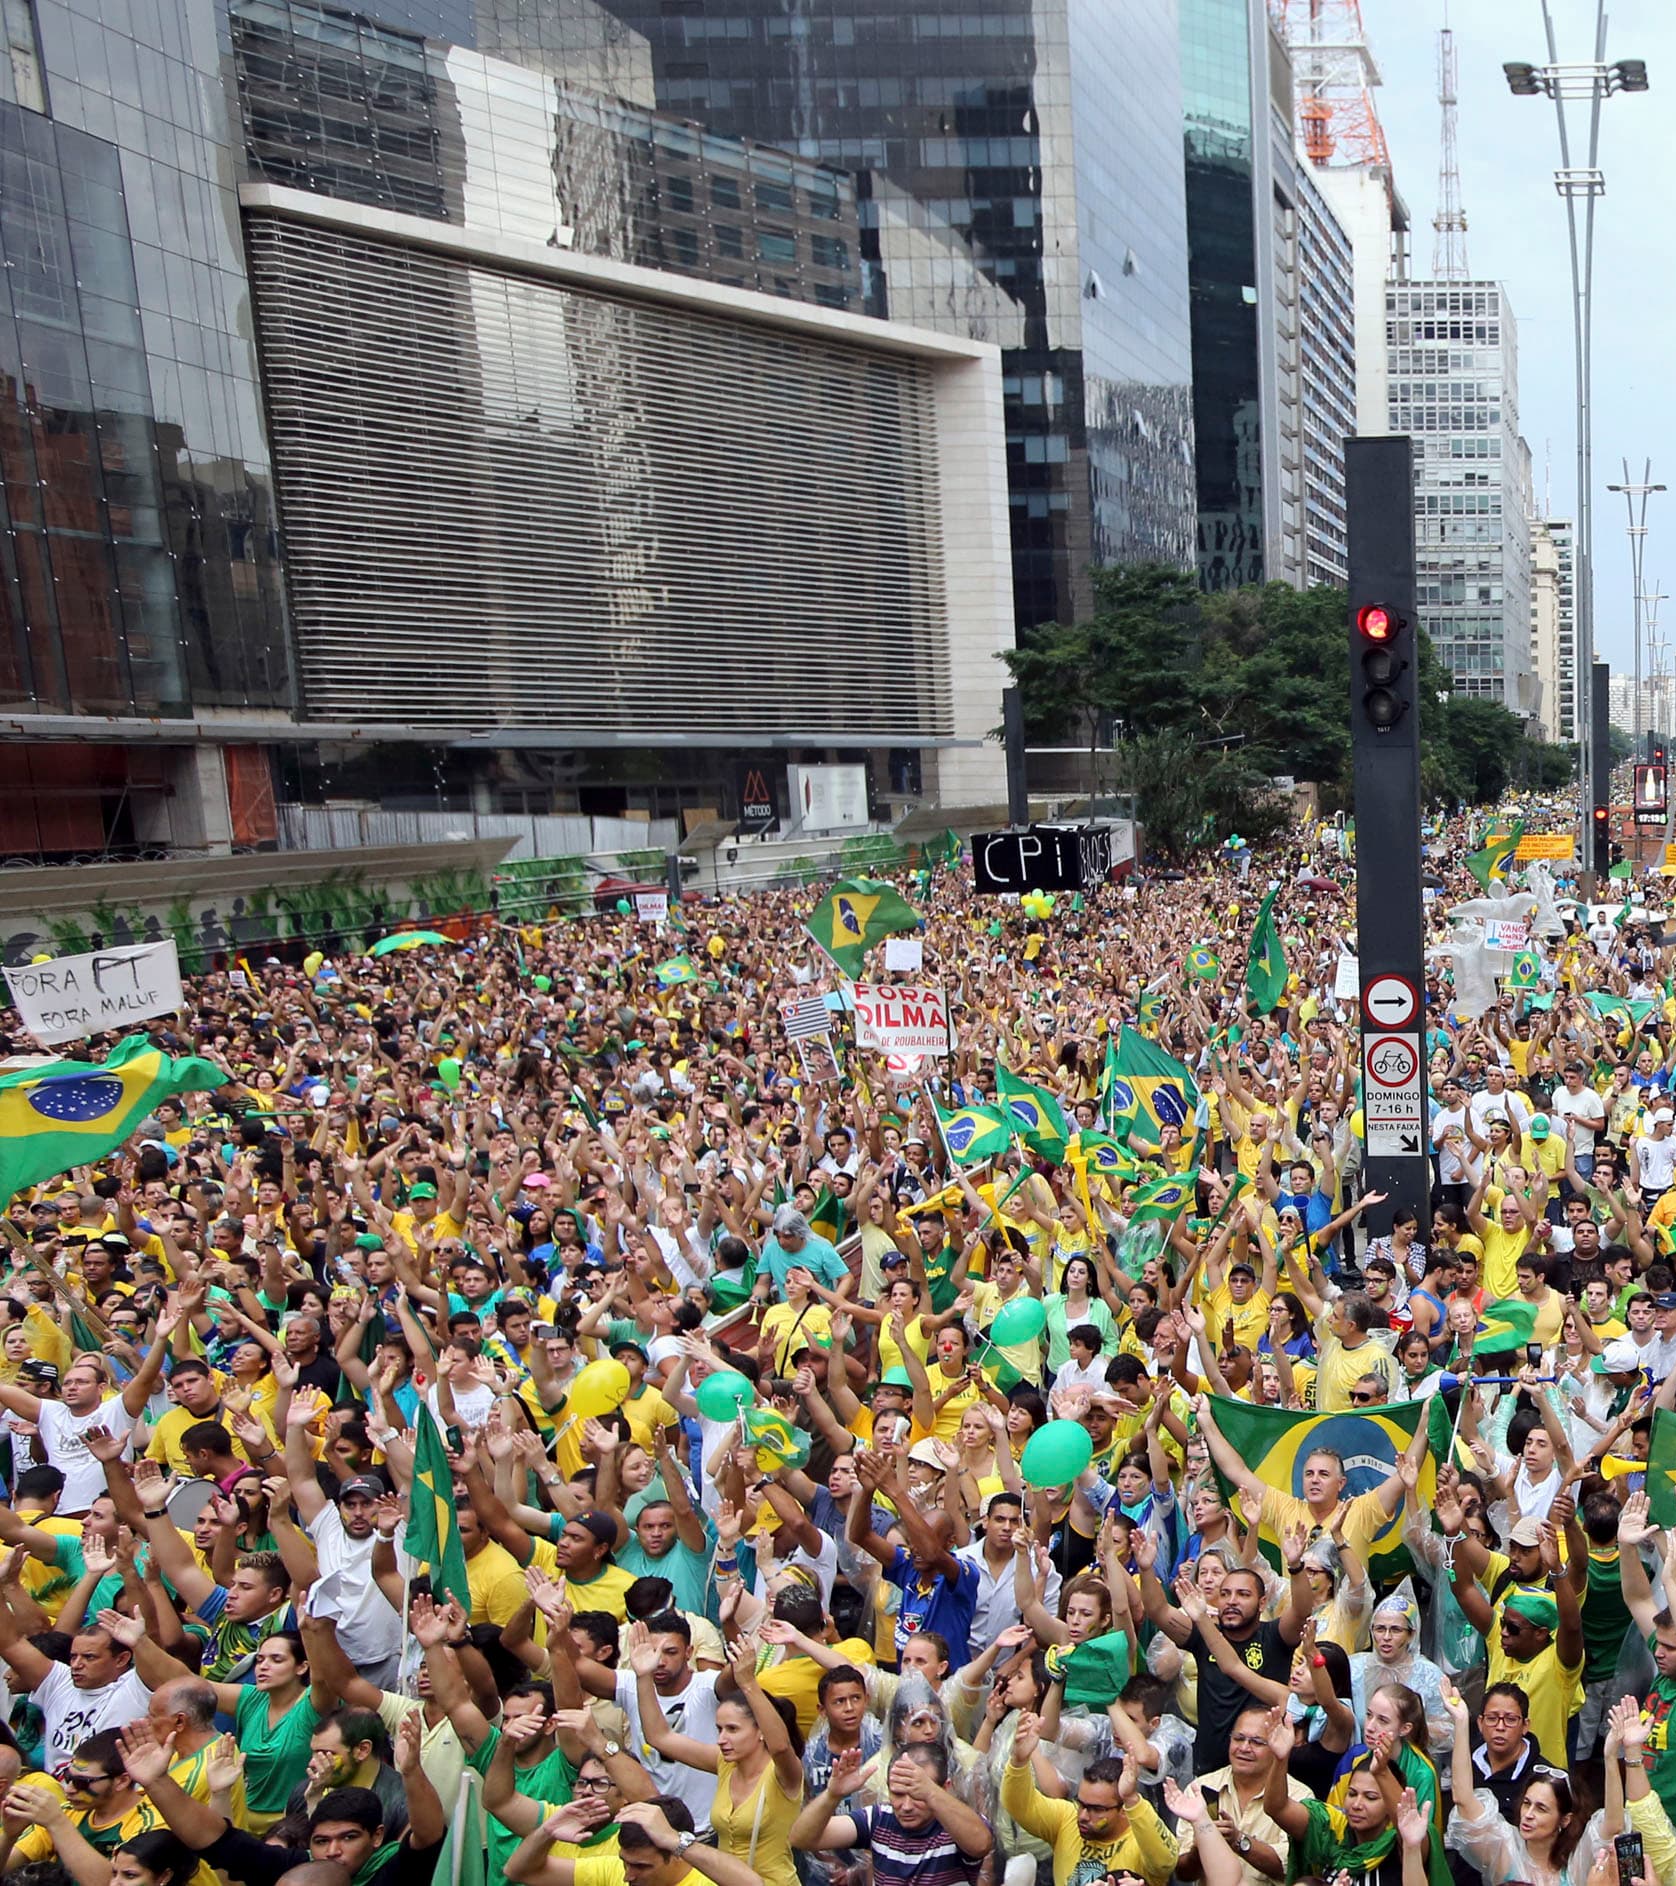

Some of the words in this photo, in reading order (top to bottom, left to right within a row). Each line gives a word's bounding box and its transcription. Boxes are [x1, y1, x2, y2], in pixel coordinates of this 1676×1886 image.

[9, 968, 81, 998] FORA
[853, 982, 942, 1007] FORA
[40, 1007, 92, 1031] FORA
[100, 990, 161, 1015] MALUF
[856, 1002, 948, 1030] DILMA
[1366, 1092, 1420, 1101] DOMINGO
[1374, 1104, 1402, 1114] 7-16
[1405, 1104, 1414, 1114] h
[1367, 1123, 1395, 1131] NESTA
[1396, 1123, 1420, 1131] FAIXA
